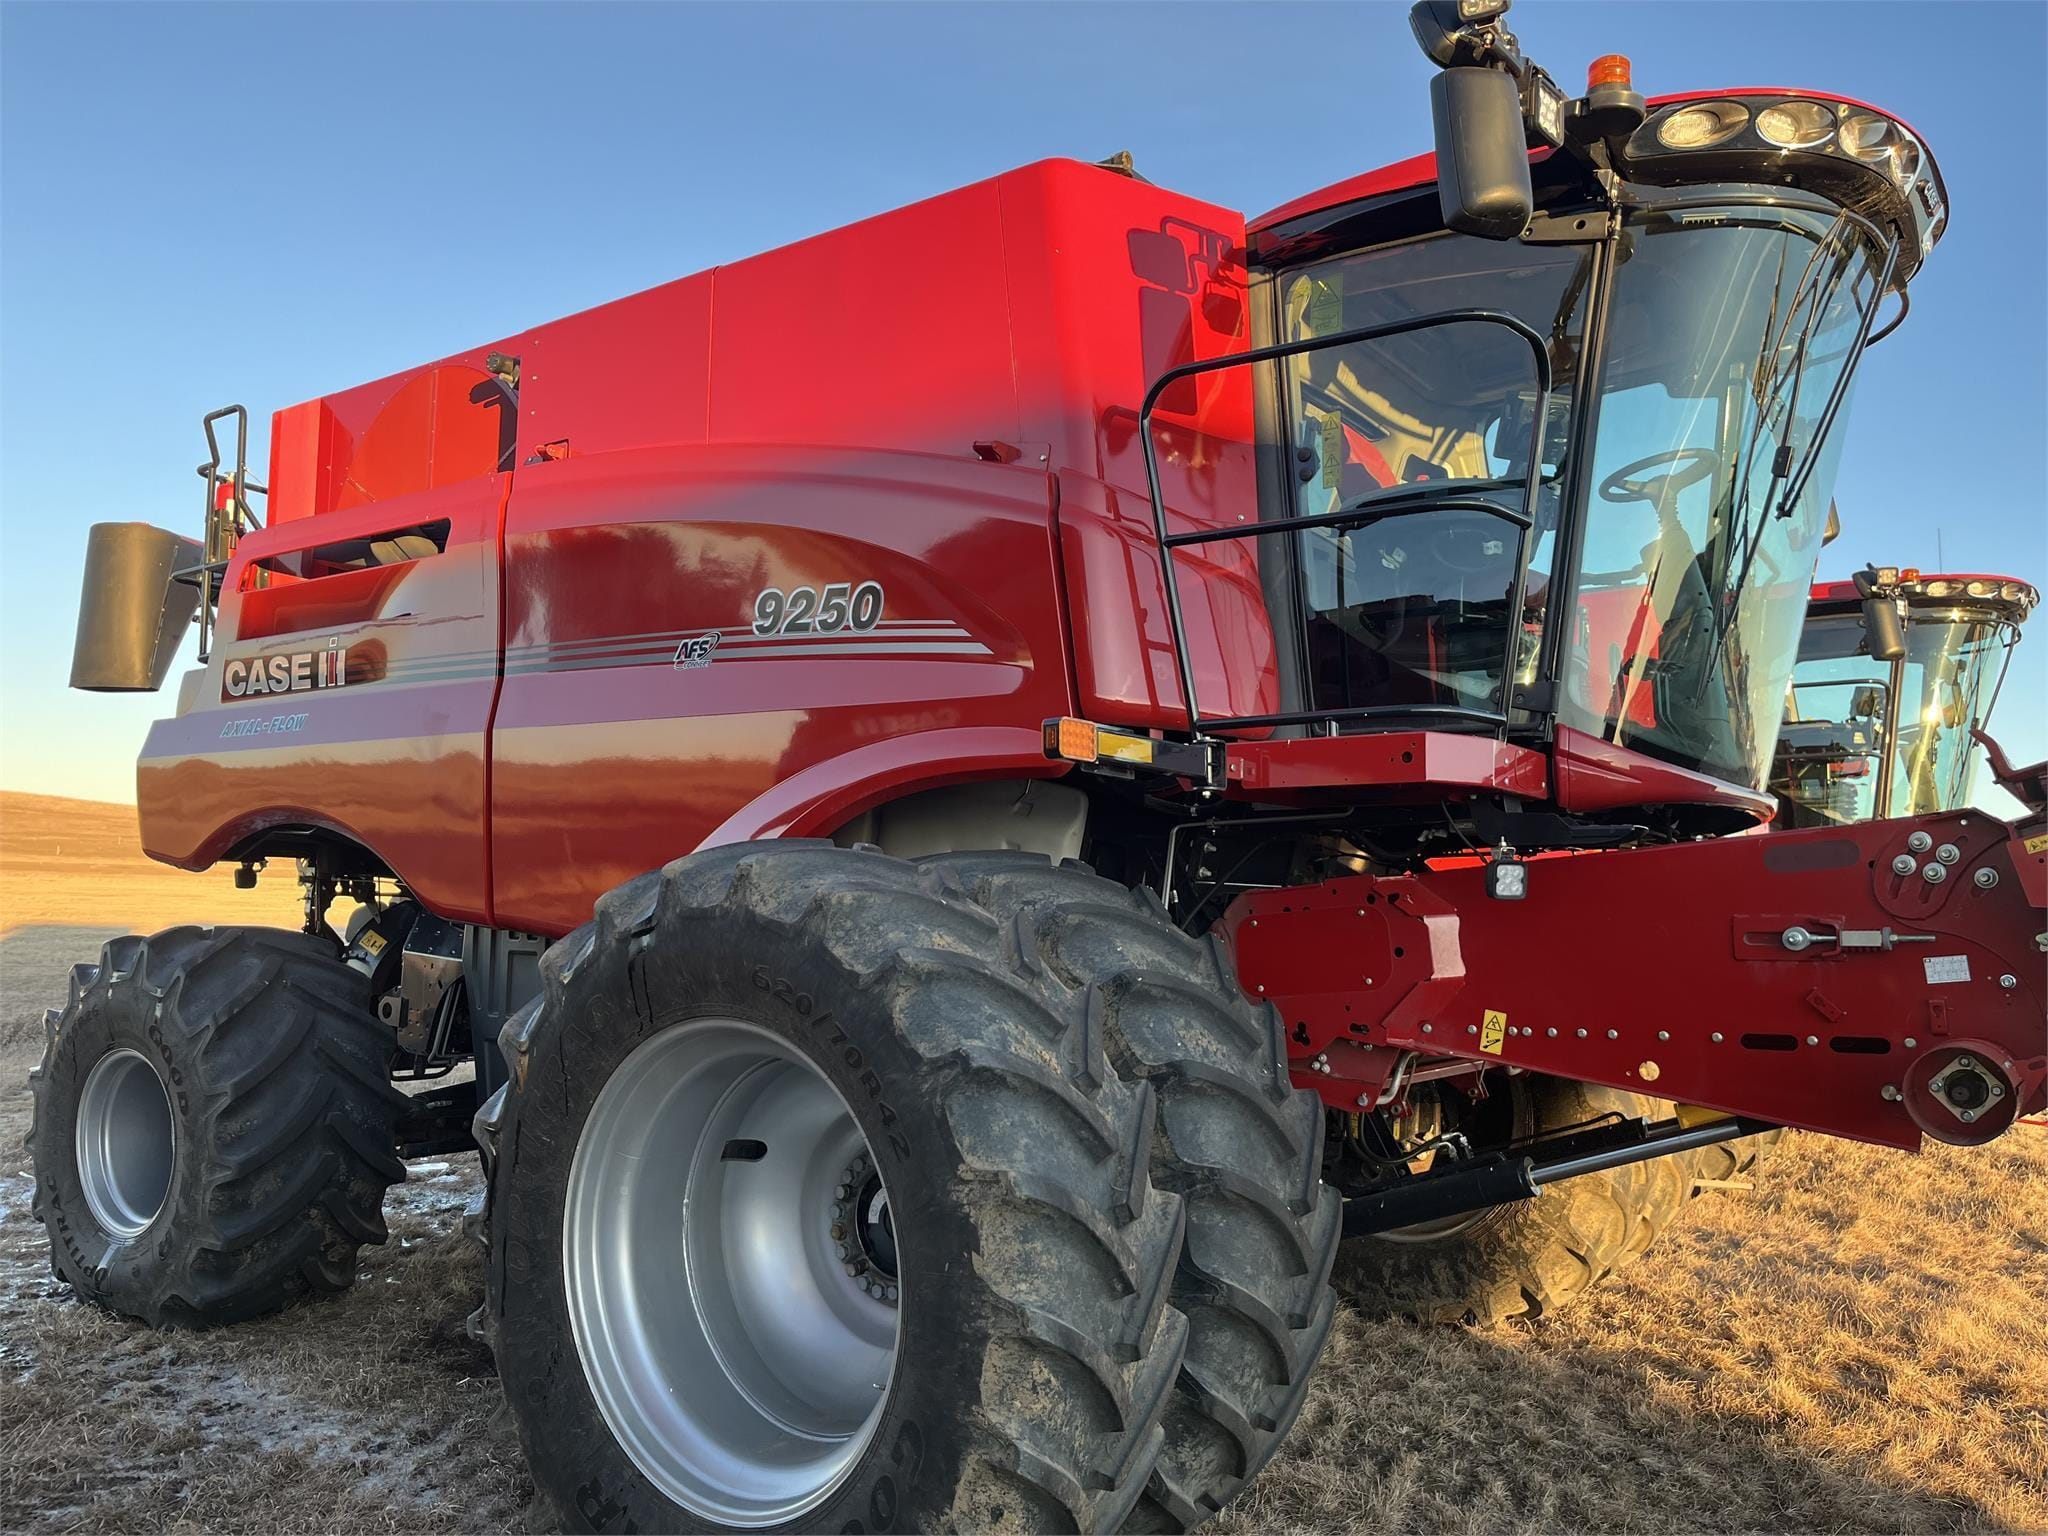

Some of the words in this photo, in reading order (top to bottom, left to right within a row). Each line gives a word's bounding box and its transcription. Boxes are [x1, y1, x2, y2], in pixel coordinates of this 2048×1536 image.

[752, 580, 884, 637] 9250
[673, 637, 712, 662] AFS
[225, 653, 312, 696] CASE
[219, 713, 309, 738] AXIAL-FLOW
[752, 965, 910, 1161] 620/70R42
